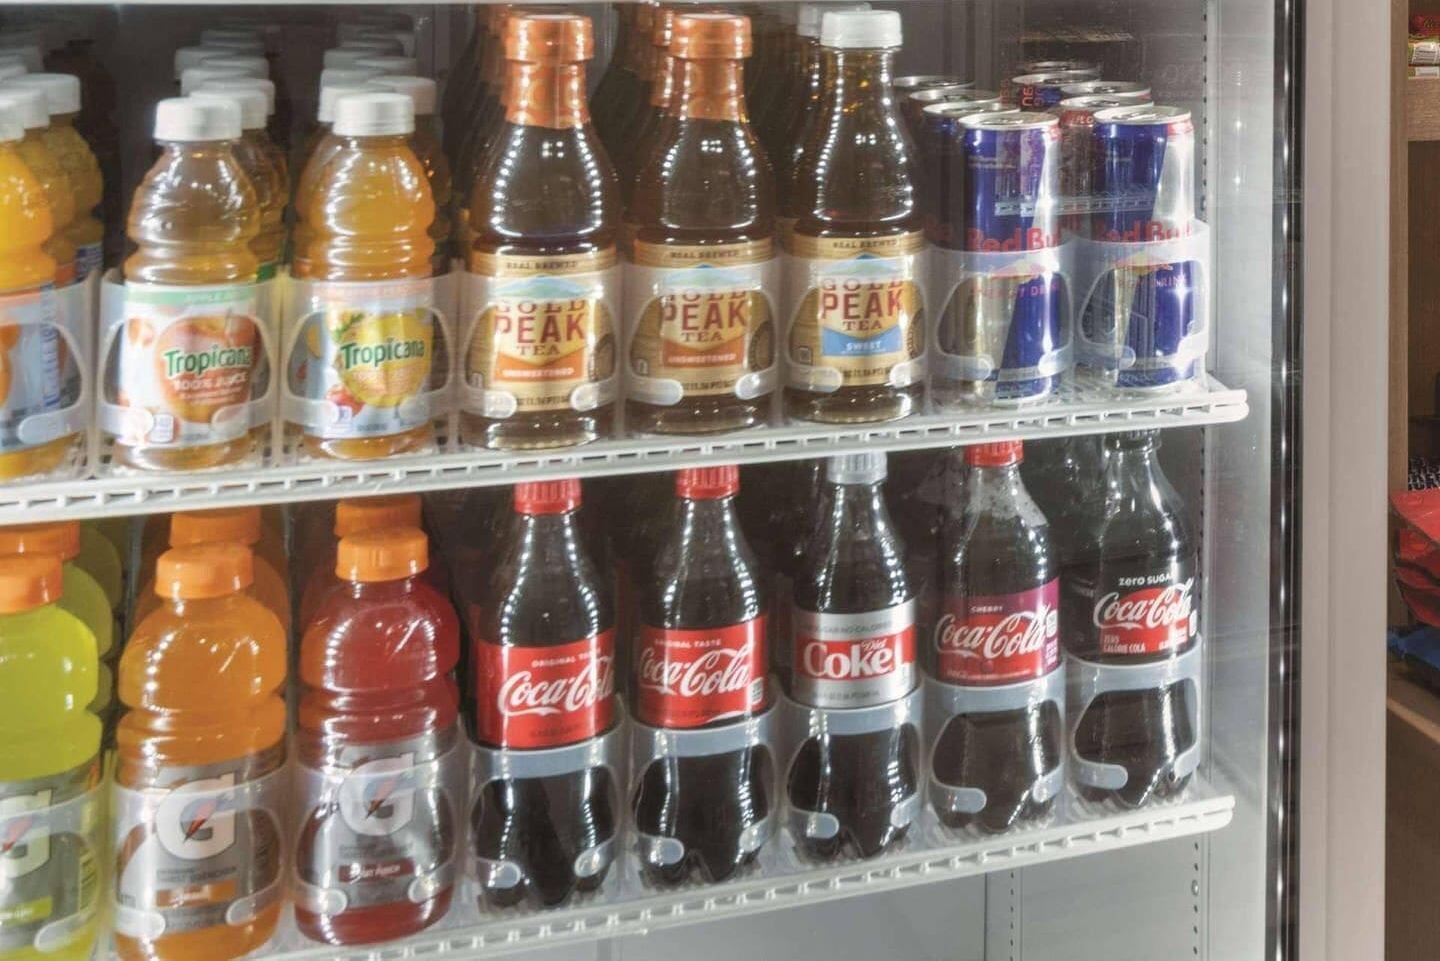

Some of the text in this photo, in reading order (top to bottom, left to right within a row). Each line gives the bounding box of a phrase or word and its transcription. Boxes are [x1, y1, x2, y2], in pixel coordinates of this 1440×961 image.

[966, 226, 1021, 253] Red
[822, 277, 904, 290] GOLD
[496, 299, 587, 314] GOLD
[821, 290, 903, 320] PEAK
[660, 301, 746, 331] PEAK
[494, 313, 586, 344] PEAK
[843, 320, 882, 331] TEA
[681, 331, 723, 343] TEA
[340, 338, 425, 369] Tropicana
[516, 344, 561, 356] TEA
[846, 341, 882, 352] SWEET
[668, 353, 738, 364] UNSWEETENED
[502, 366, 575, 378] UNSWEETENED
[1117, 572, 1177, 587] zero SUGA
[970, 605, 1003, 613] CHERRY
[1093, 579, 1194, 630] Coca-Cola
[693, 639, 721, 648] TASTE
[1129, 642, 1147, 653] COLA
[531, 656, 576, 669] ORIGINAL
[803, 642, 894, 679] Coke
[638, 642, 757, 698] Coca-Cola
[339, 752, 416, 837] G
[156, 772, 238, 861] G
